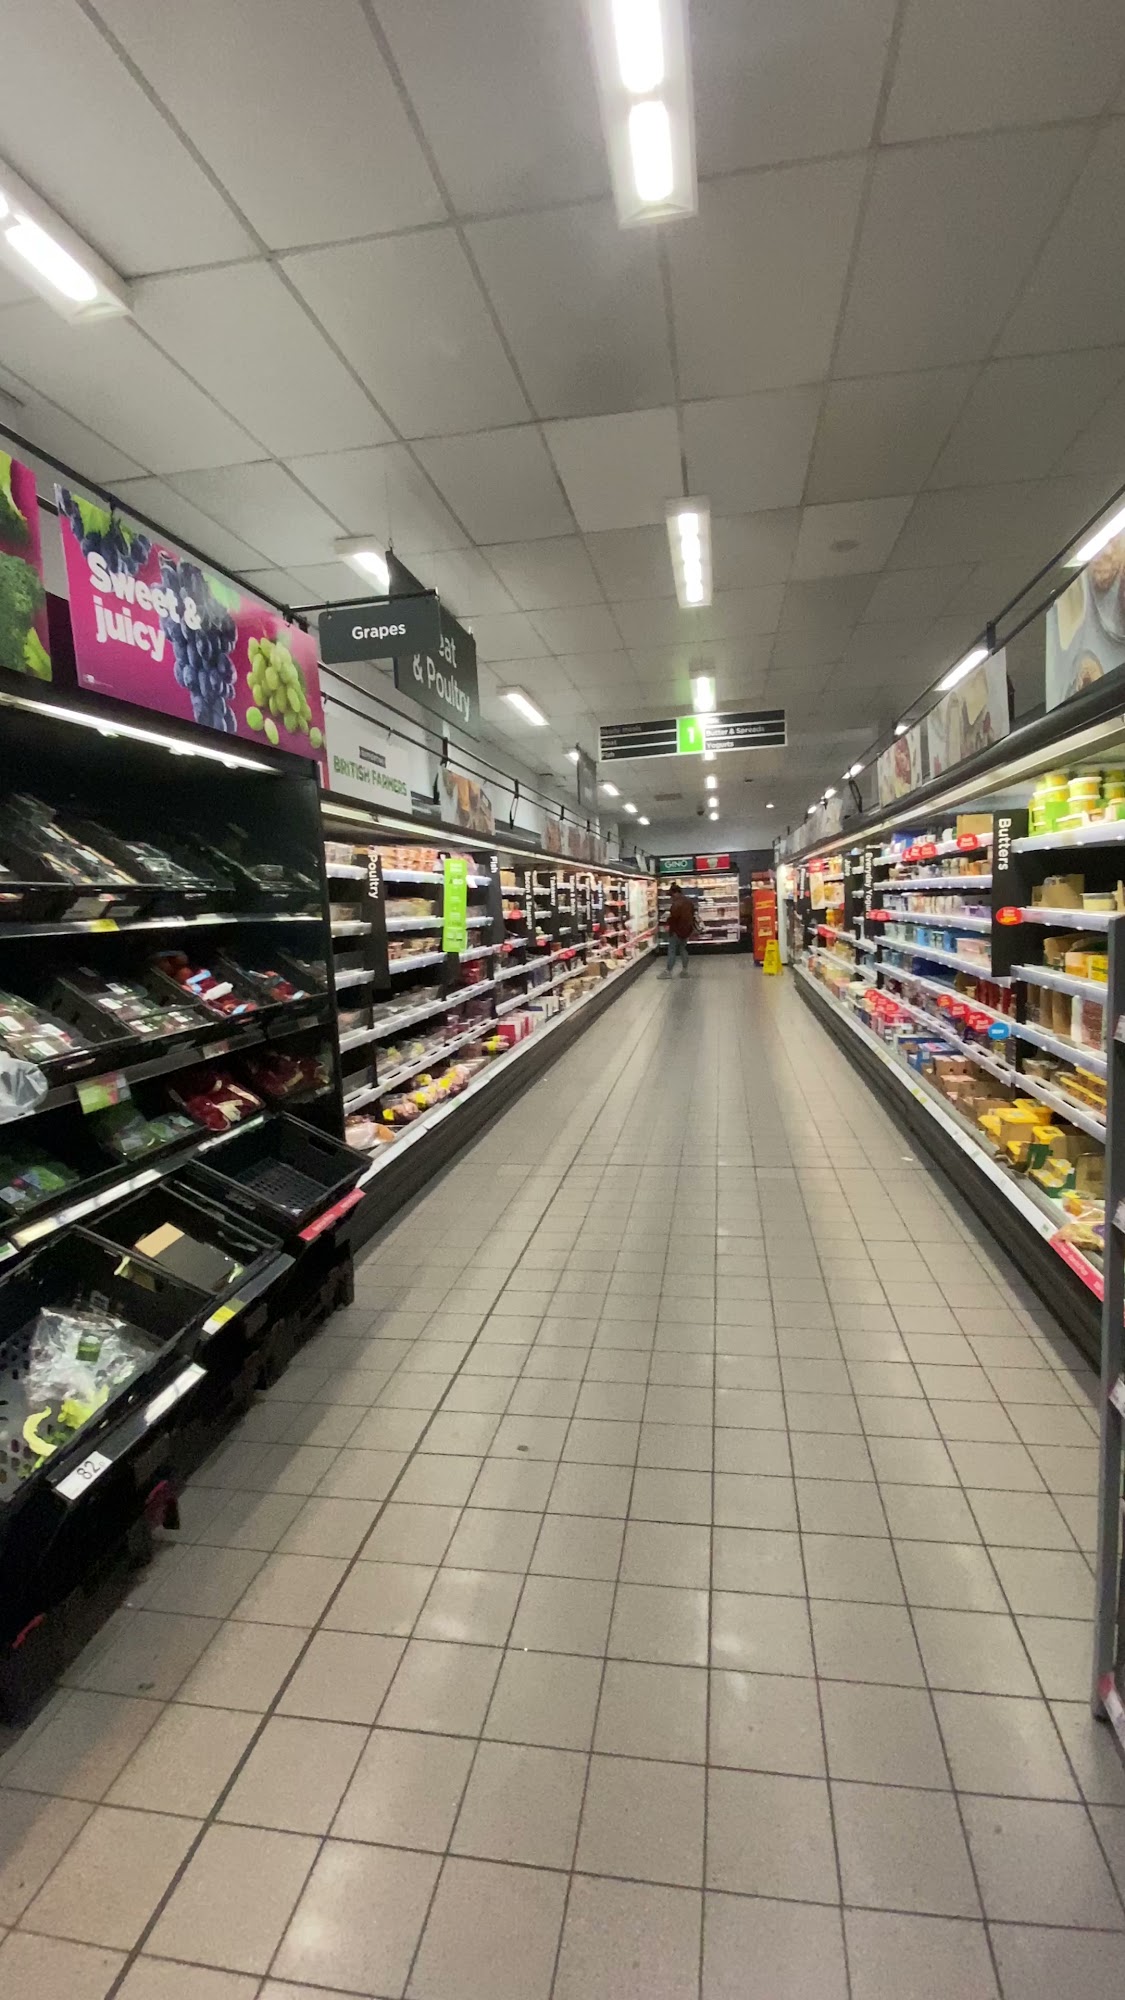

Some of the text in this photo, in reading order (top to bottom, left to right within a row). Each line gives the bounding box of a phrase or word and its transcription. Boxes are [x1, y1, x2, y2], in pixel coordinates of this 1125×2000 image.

[87, 551, 202, 630] Sweet &
[93, 594, 165, 662] juicy
[351, 623, 407, 640] Grapes
[438, 633, 457, 668] eat
[412, 653, 470, 722] & Poultry
[687, 727, 695, 744] 1
[705, 728, 728, 736] Butter
[706, 741, 735, 749] Yogurts
[333, 755, 371, 784] BRITISH
[371, 769, 408, 797] FARMERS
[997, 818, 1012, 871] Butters
[368, 852, 380, 899] Poultry
[490, 855, 498, 874] Fish
[864, 852, 873, 888] Everyday
